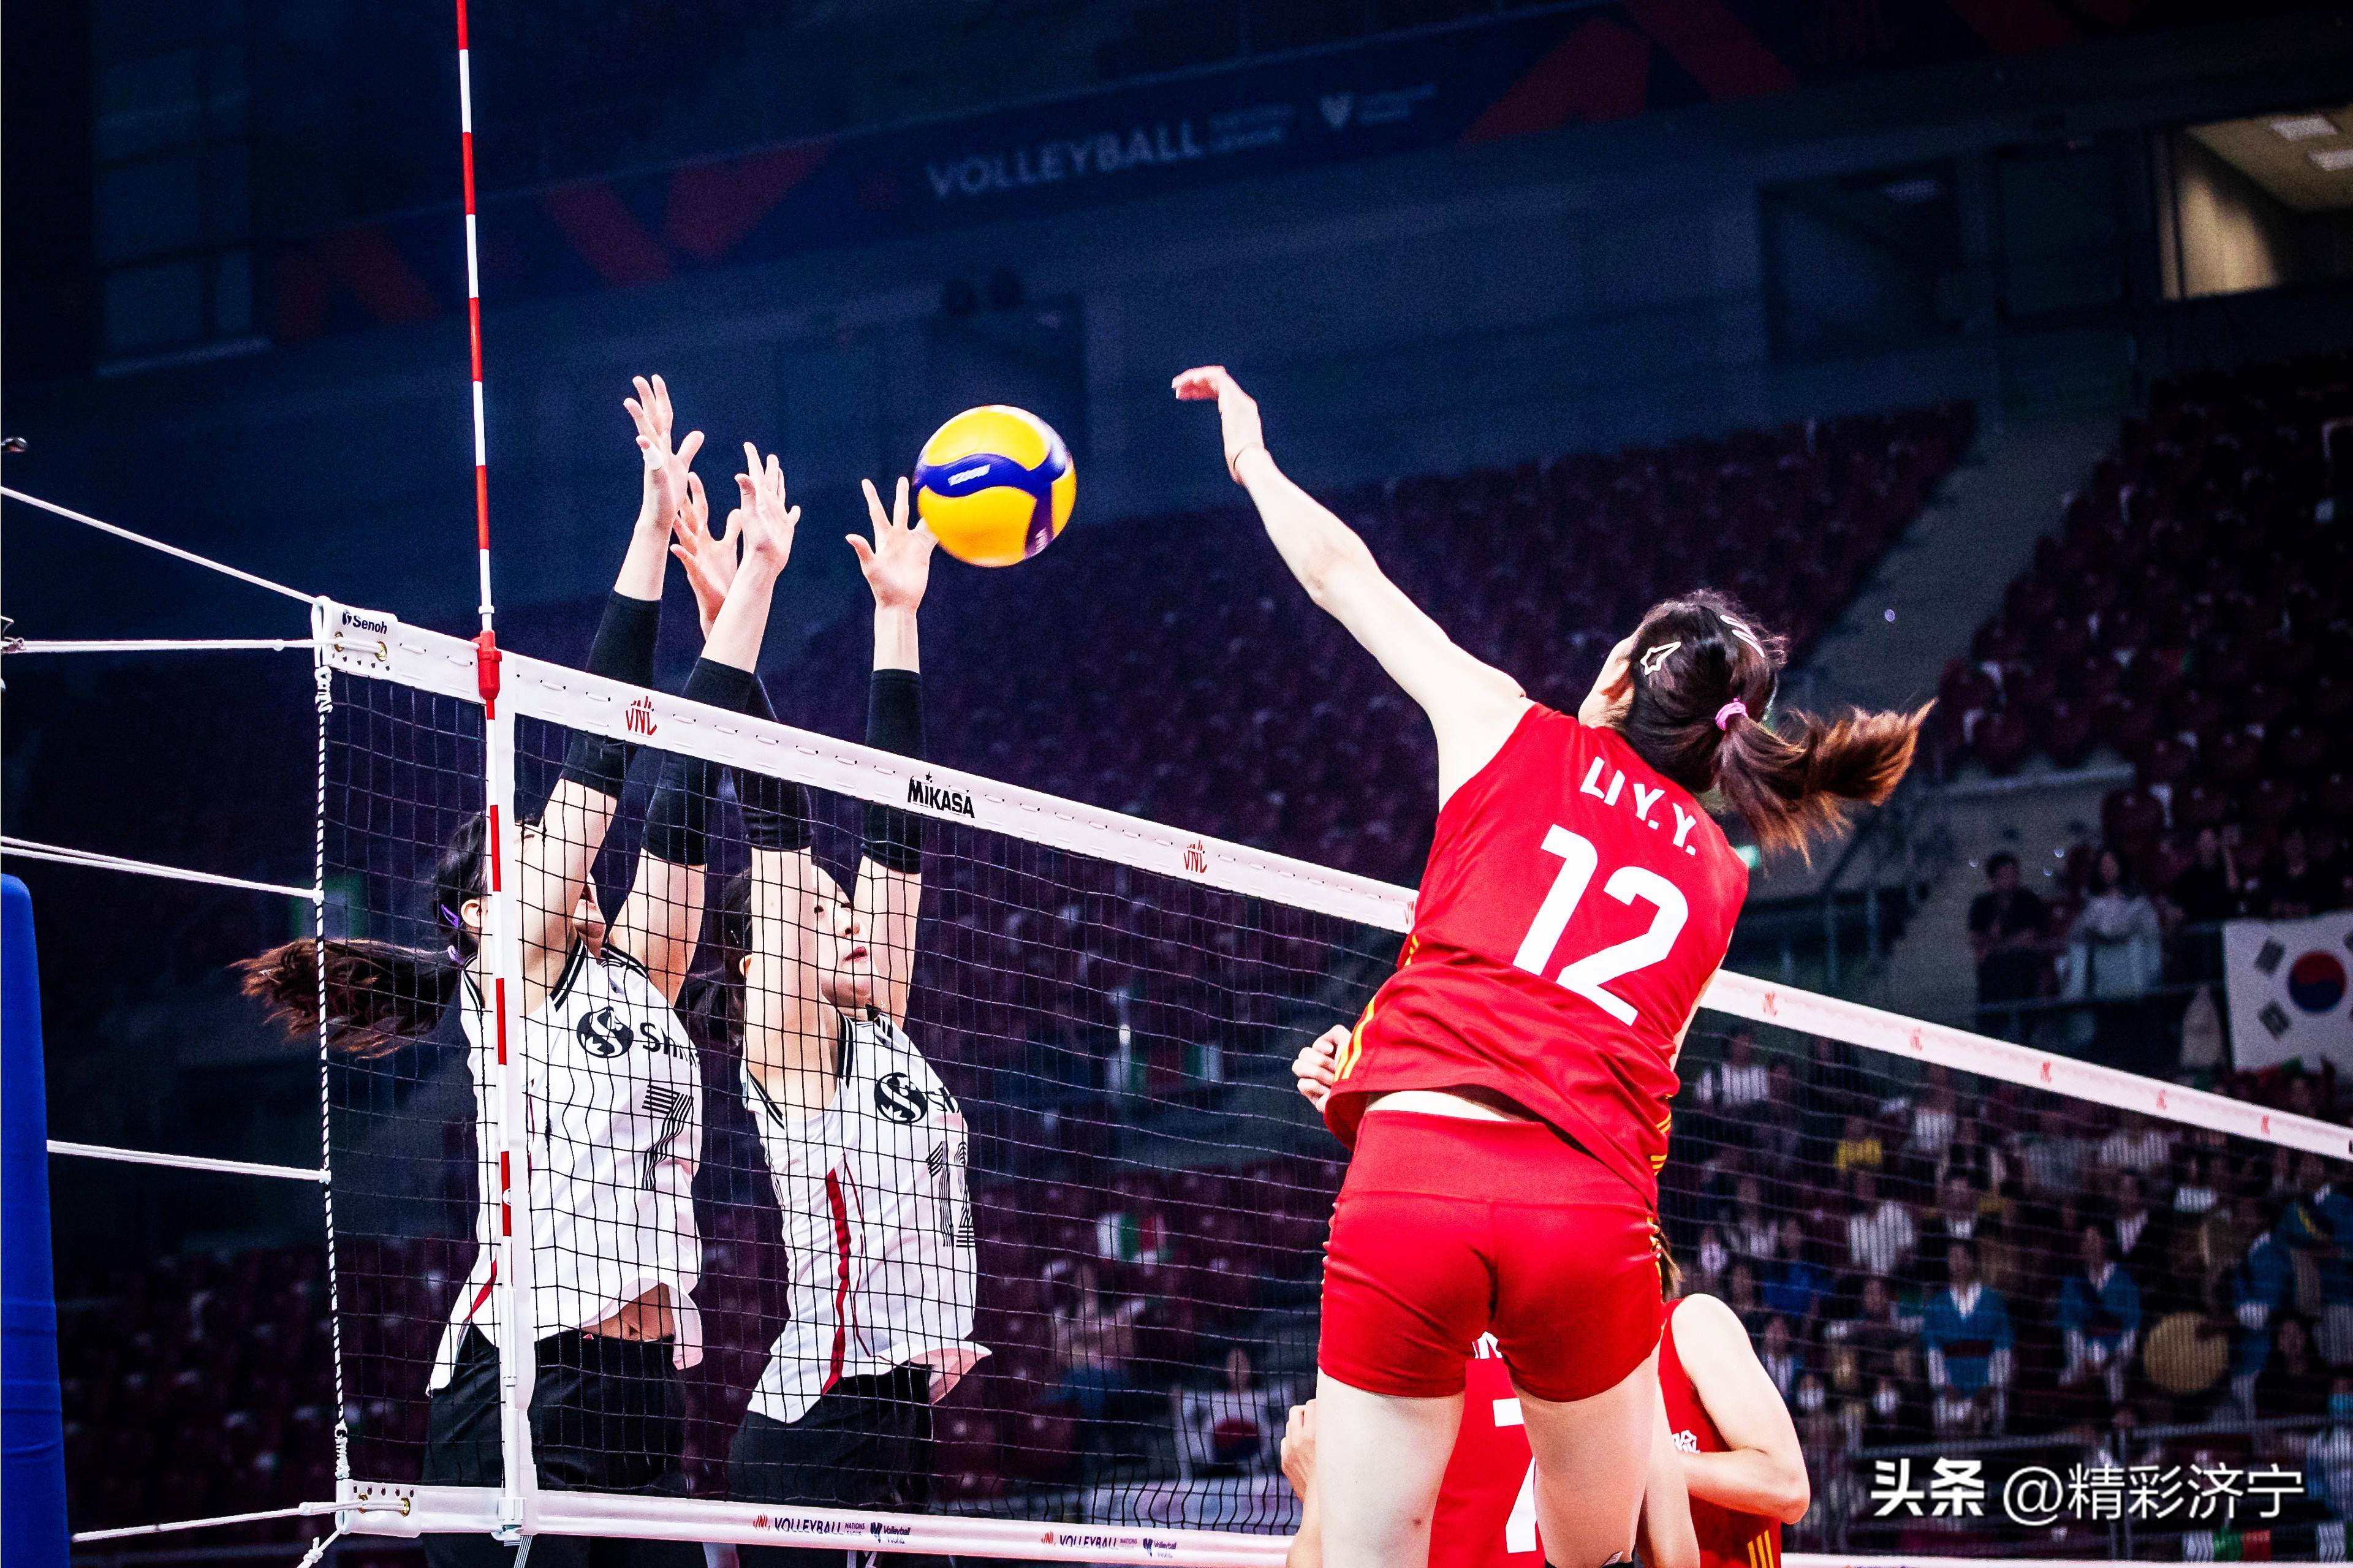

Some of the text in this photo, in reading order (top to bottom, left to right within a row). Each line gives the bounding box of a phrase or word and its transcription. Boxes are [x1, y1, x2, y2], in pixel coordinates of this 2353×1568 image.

[926, 121, 1204, 199] VOLLEYBALL
[352, 615, 388, 635] Senoh
[907, 778, 975, 819] MIKASA
[1512, 824, 1689, 1027] 12
[775, 1517, 844, 1534] VOLLEYBALL
